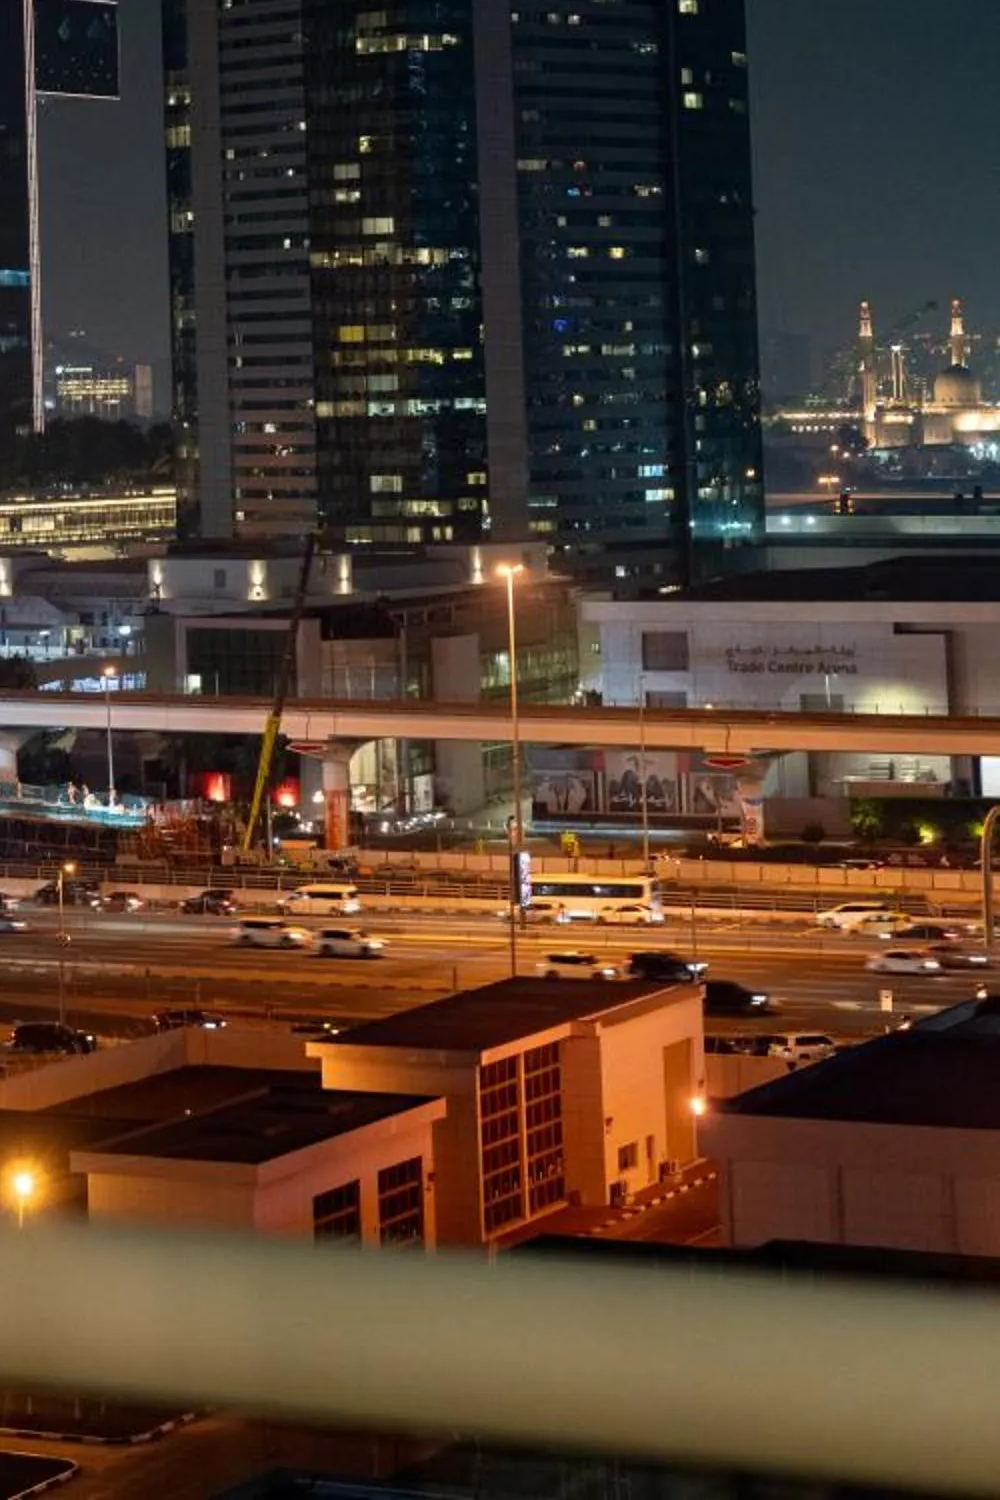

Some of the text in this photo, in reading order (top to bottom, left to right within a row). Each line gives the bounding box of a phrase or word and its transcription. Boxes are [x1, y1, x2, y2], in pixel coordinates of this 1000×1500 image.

[727, 660, 858, 675] Trade Centre Arena
